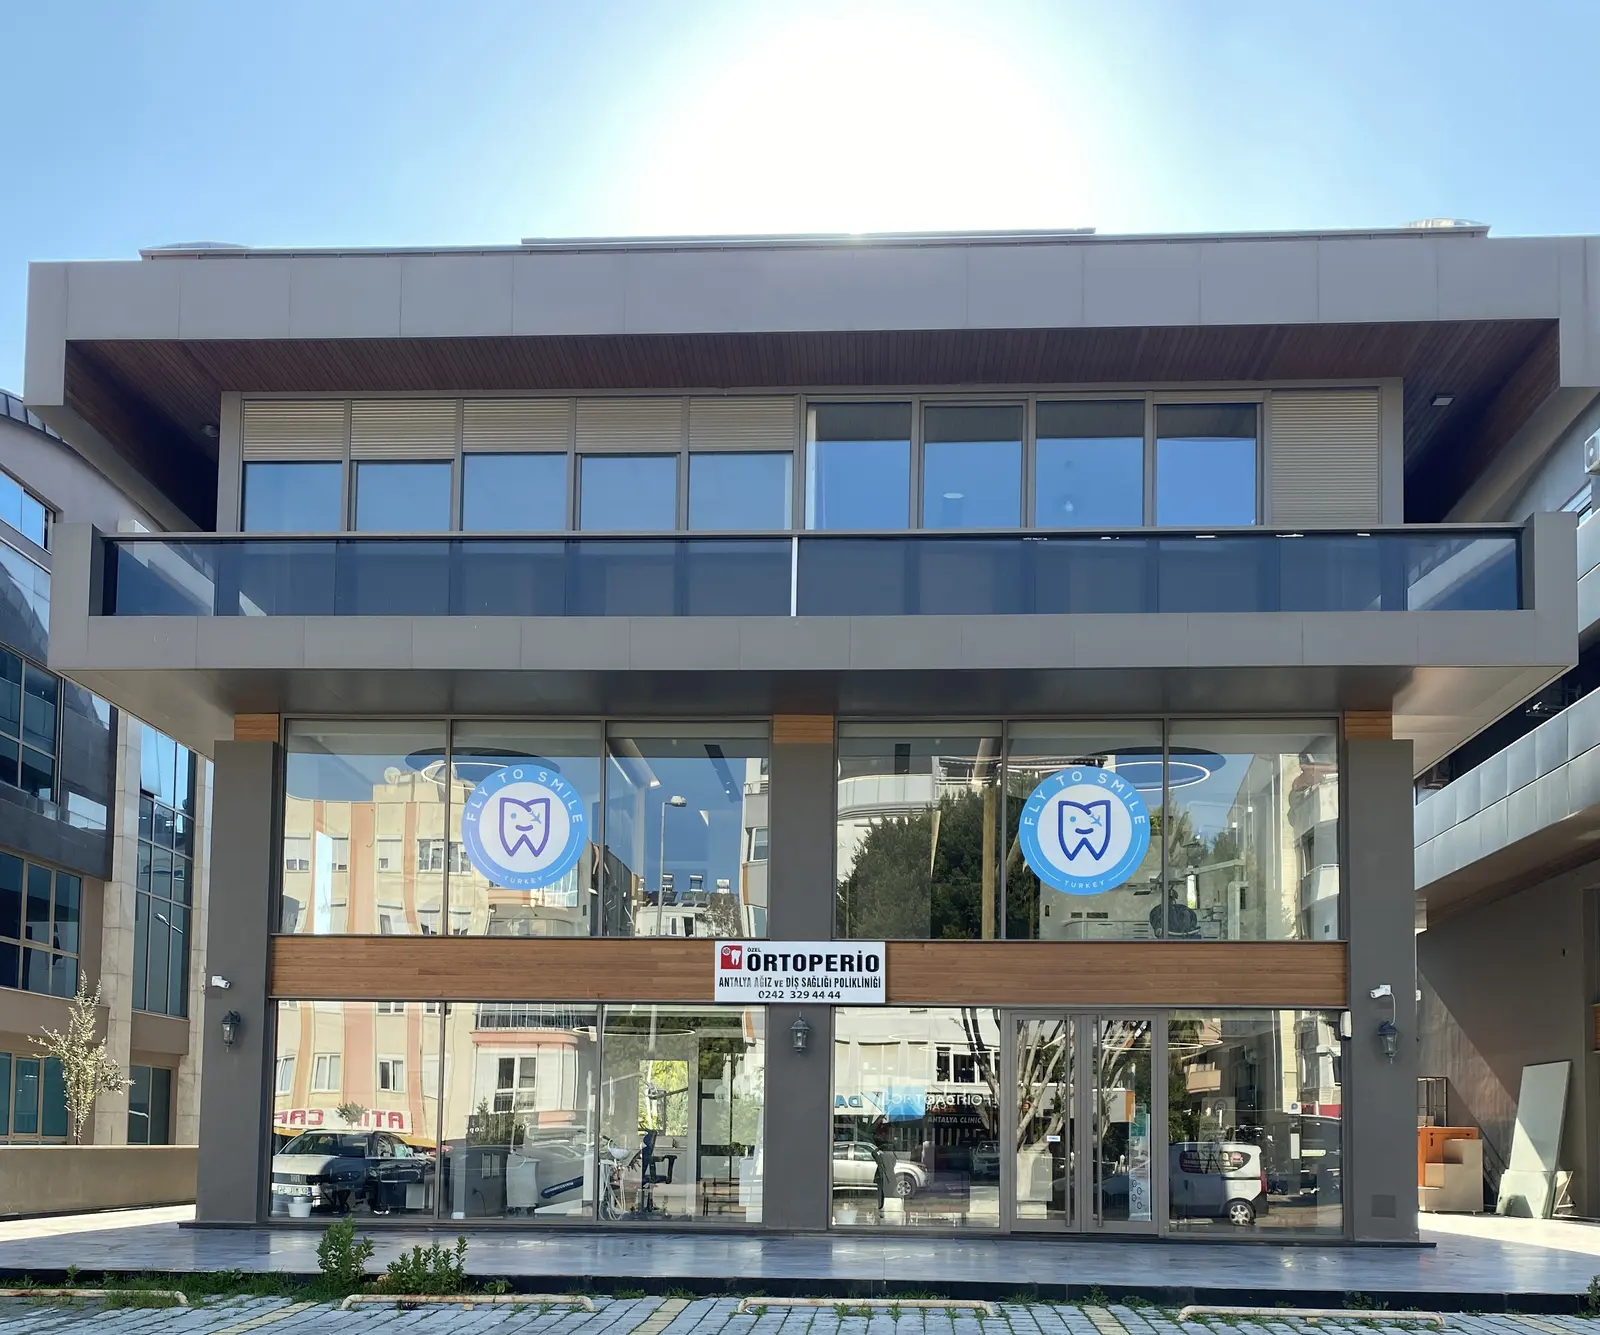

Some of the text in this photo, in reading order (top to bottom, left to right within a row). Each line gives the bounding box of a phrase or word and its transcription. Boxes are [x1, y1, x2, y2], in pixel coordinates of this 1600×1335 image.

[467, 768, 583, 823] FLY TO SMILE
[1024, 771, 1145, 826] FLY TO SMILE
[504, 876, 543, 885] TURKEY
[1064, 880, 1104, 889] TURKEY
[747, 950, 880, 972] ORTOPERİO
[719, 977, 752, 987] ANTALYA
[786, 975, 799, 989] DİŞ
[758, 990, 841, 999] 0242 329 44 44
